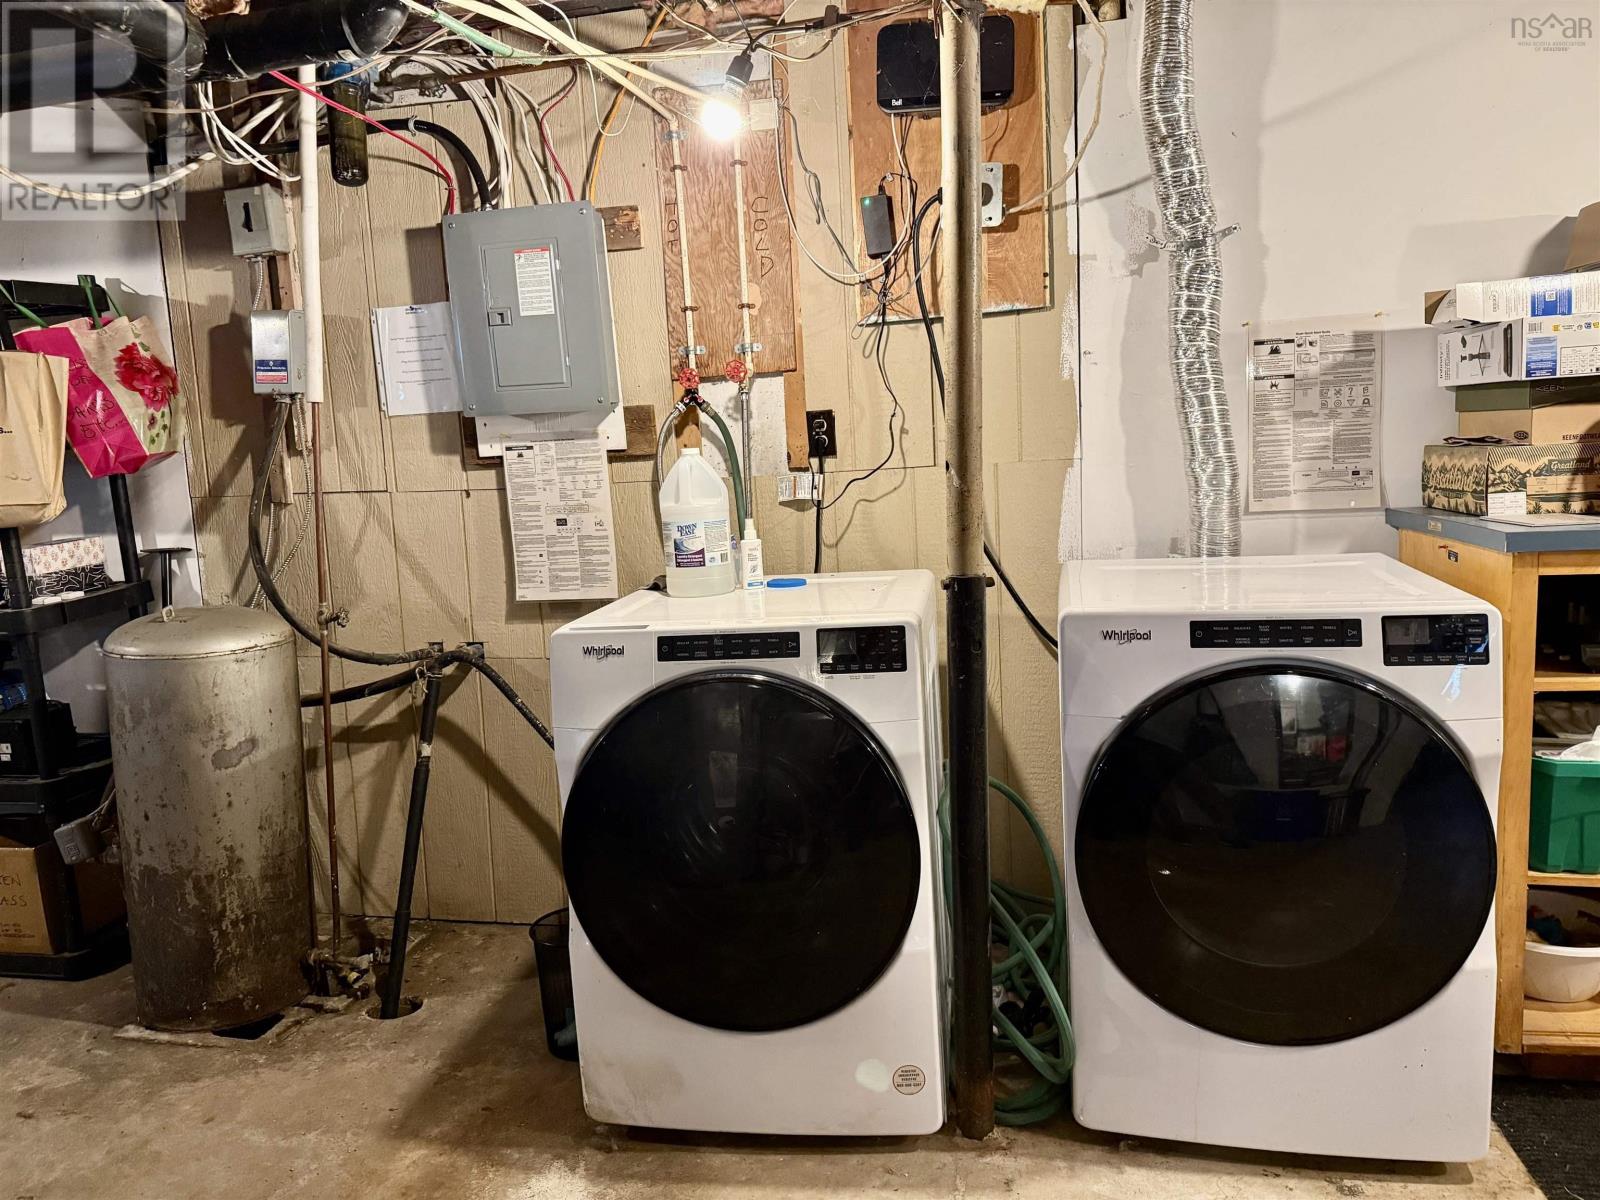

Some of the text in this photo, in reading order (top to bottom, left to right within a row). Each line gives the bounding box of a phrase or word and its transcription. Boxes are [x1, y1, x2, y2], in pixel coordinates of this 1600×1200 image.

[891, 98, 903, 106] Bell
[664, 197, 678, 254] HOT
[751, 196, 775, 278] COLD
[1550, 460, 1591, 473] Greatland
[676, 522, 697, 532] DOWN
[680, 528, 696, 537] EAST
[1101, 628, 1152, 645] Whirlpool
[582, 644, 625, 660] Whirlpool
